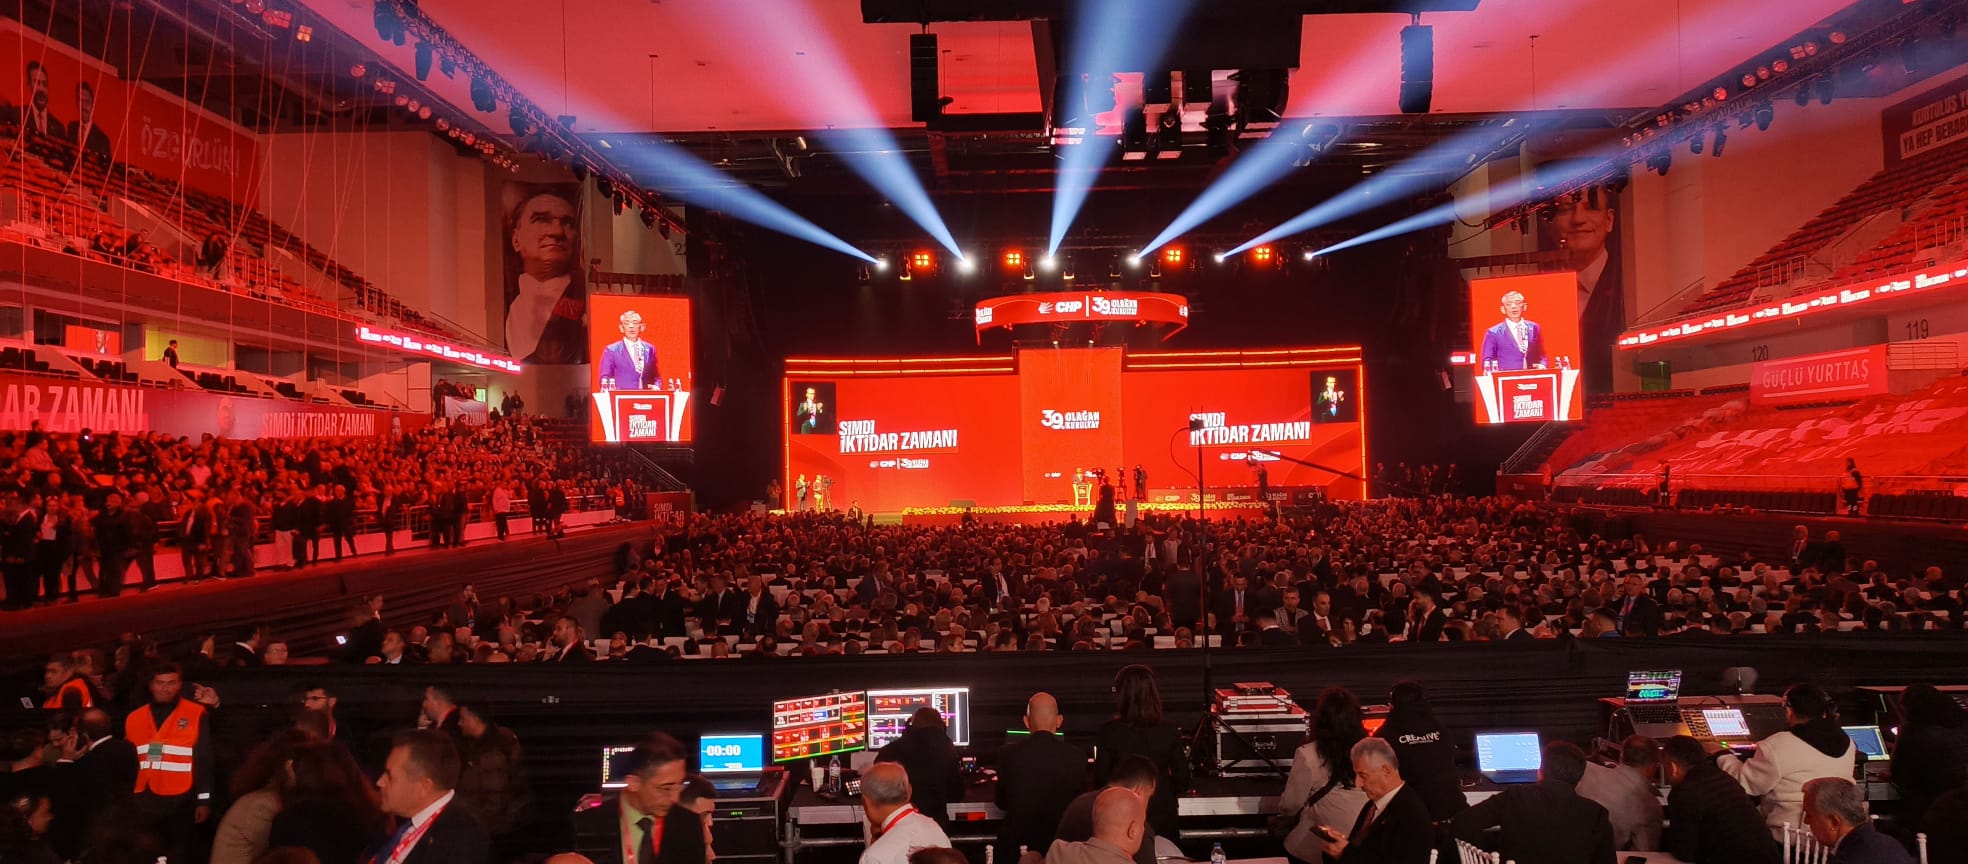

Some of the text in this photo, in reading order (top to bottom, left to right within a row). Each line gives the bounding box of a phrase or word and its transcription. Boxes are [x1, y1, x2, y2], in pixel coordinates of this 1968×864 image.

[1055, 301, 1082, 313] CHP
[1906, 319, 1929, 340] 119
[1751, 344, 1769, 362] 120
[1763, 358, 1869, 390] GÜÇLÜ YURTTAŞ
[46, 386, 144, 433] ZAMANI
[339, 412, 375, 436] ZAMANI
[1251, 421, 1310, 442] ZAMANI
[900, 429, 958, 450] ZAMANI
